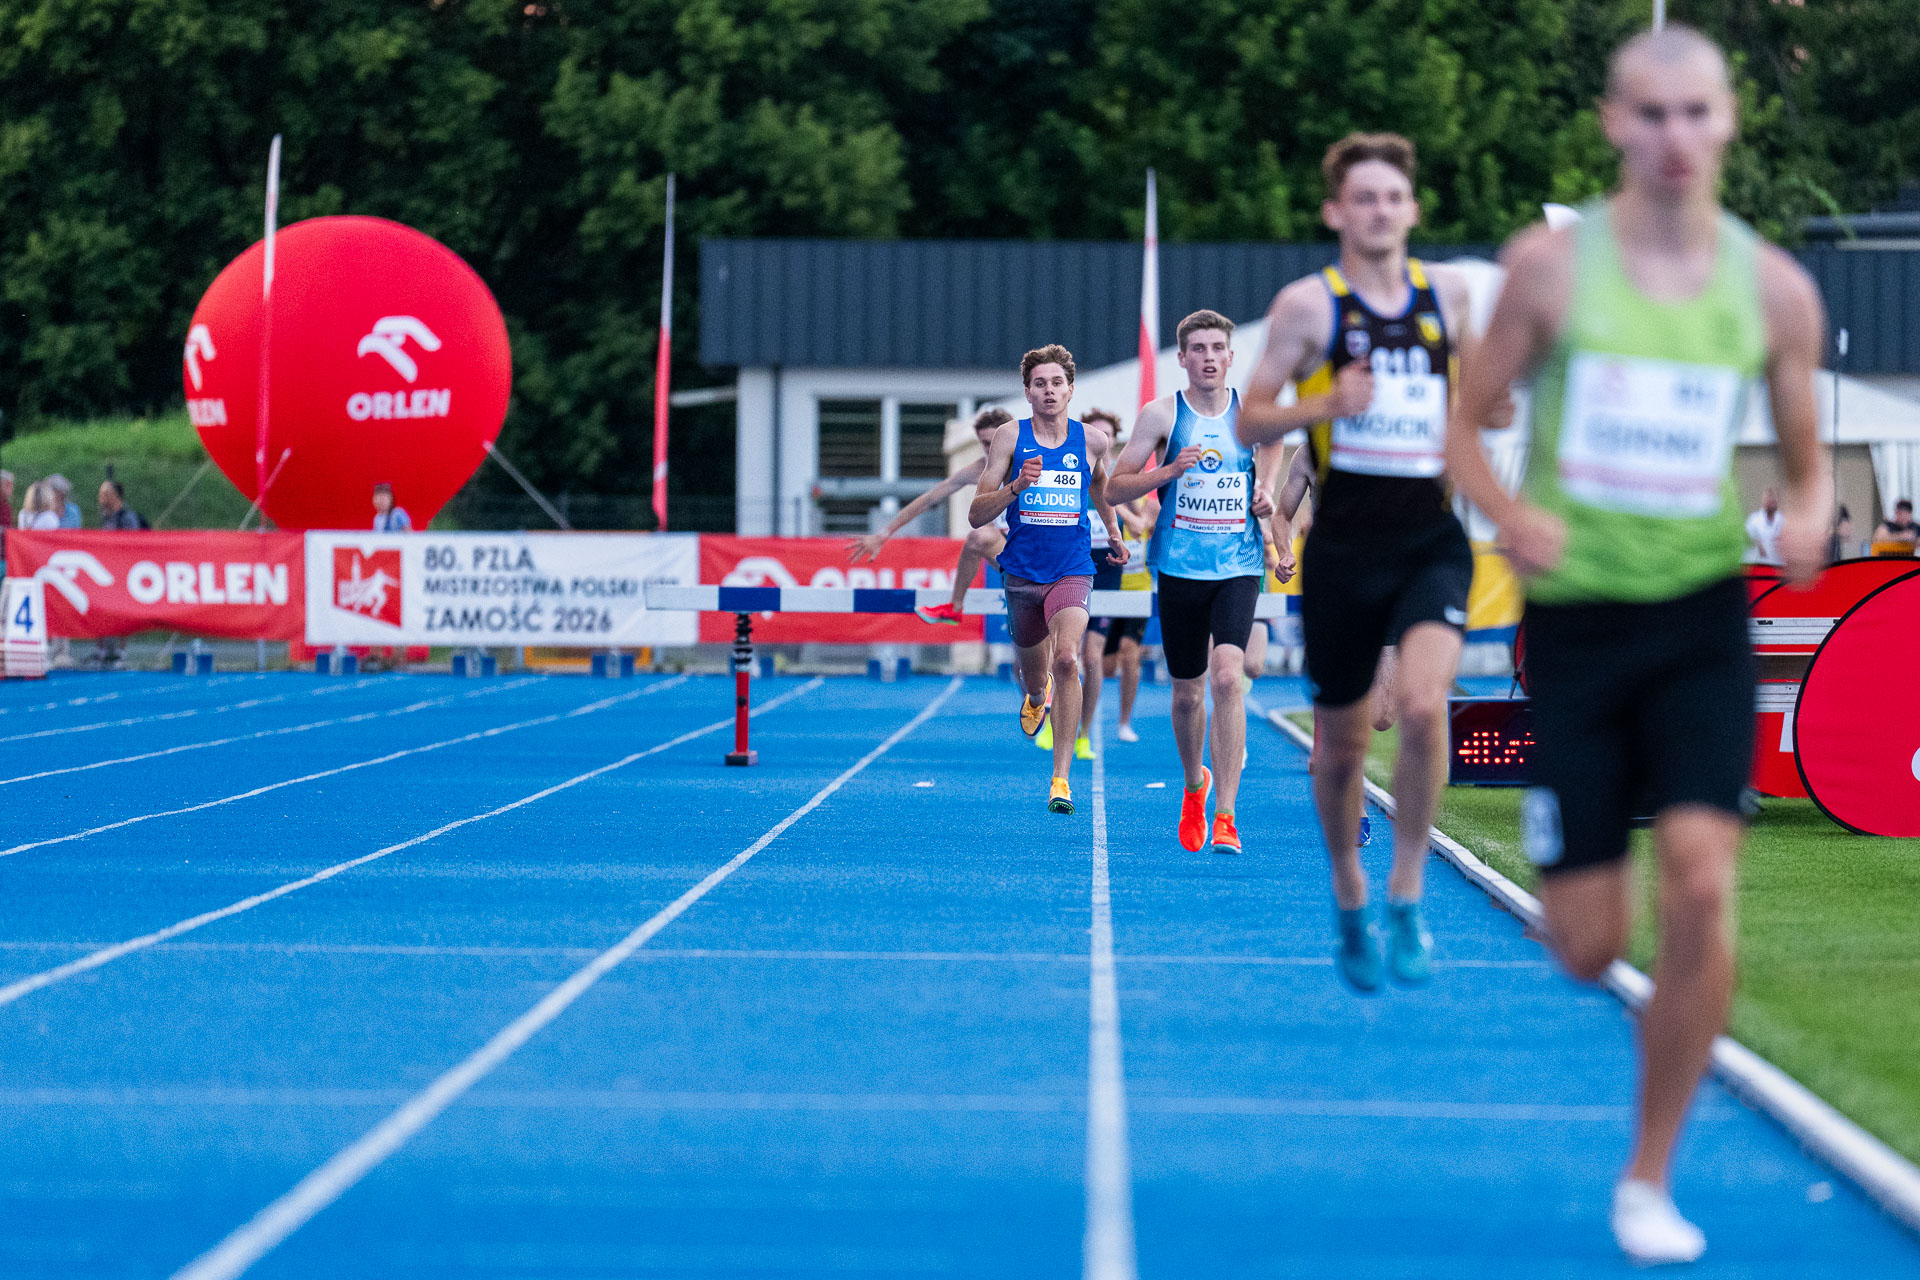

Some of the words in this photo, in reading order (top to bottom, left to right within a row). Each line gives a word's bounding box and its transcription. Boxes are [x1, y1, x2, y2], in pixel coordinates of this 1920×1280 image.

[346, 388, 451, 421] ORLEN
[1053, 474, 1076, 485] 486
[1216, 476, 1241, 489] 676
[1024, 492, 1075, 507] GAJDUS
[1178, 493, 1243, 514] ŚWIĄTEK
[473, 545, 535, 571] PZLA
[127, 560, 287, 605] ORLEN
[424, 578, 564, 595] MISTRZOSTWA
[570, 578, 638, 597] POLSKI
[15, 595, 33, 633] 4
[424, 600, 542, 632] ZAMOŚĆ
[553, 607, 612, 632] 2026
